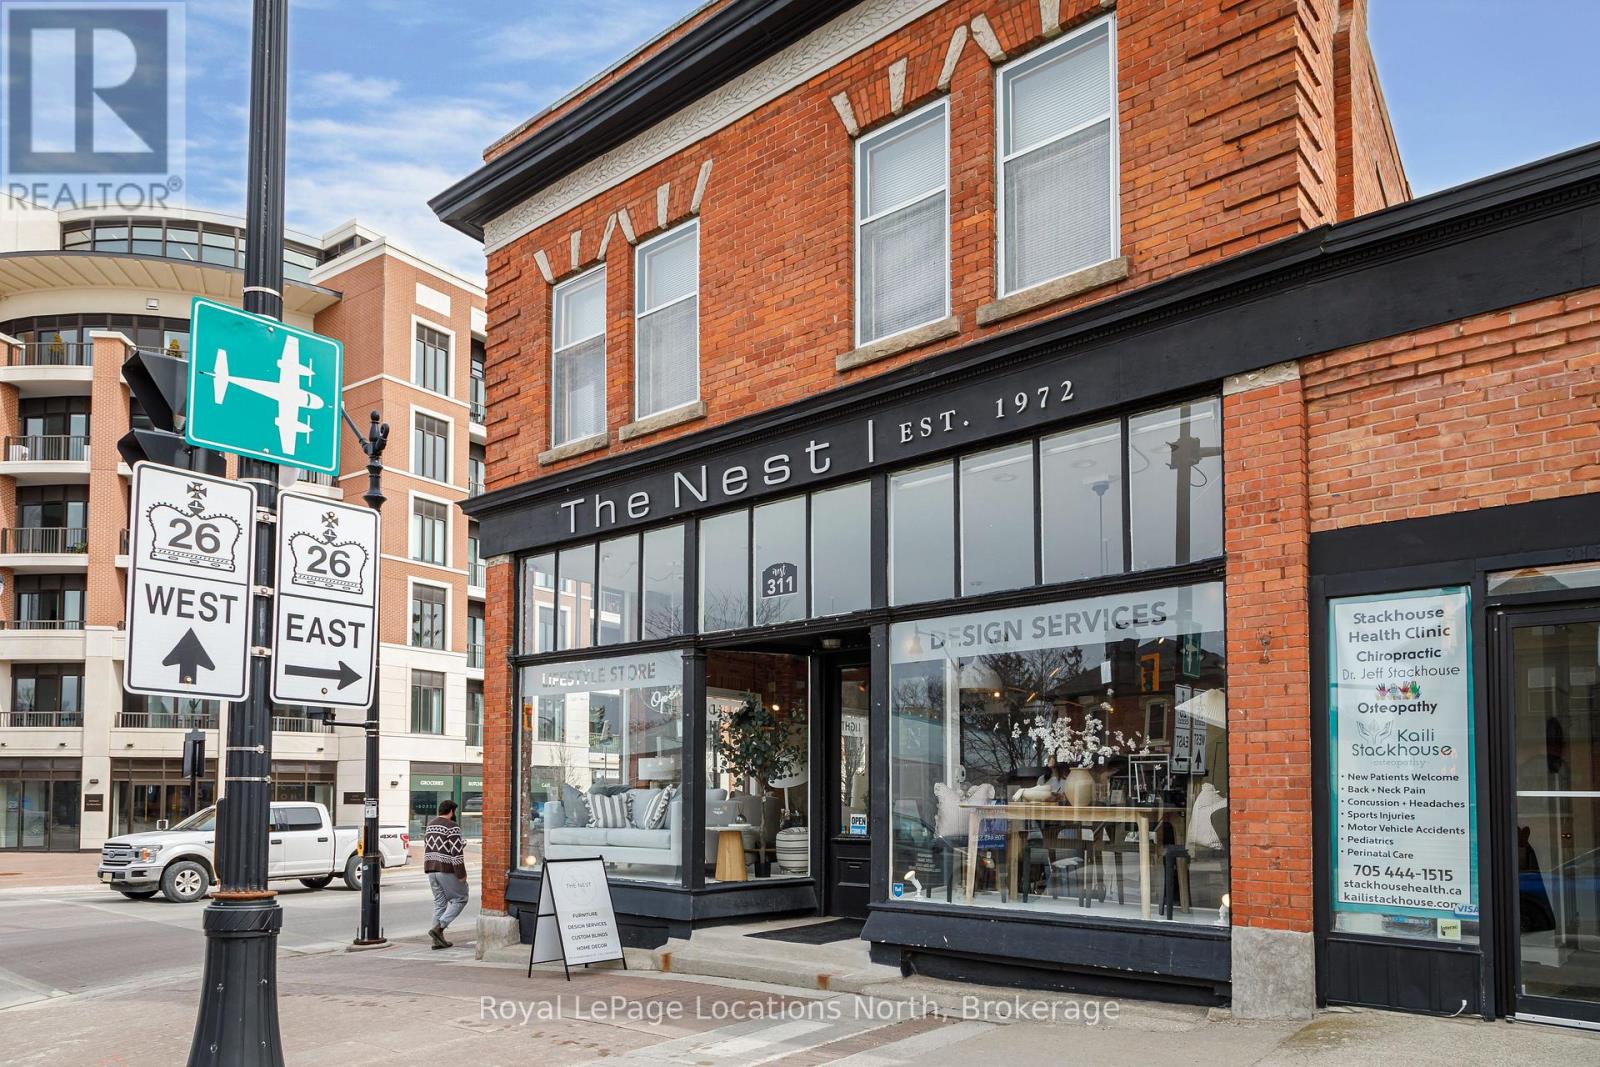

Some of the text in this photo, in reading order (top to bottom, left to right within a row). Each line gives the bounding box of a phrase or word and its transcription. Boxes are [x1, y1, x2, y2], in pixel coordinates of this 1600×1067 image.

[899, 380, 1074, 443] EST. 1972
[561, 440, 830, 533] The Nest
[168, 518, 221, 554] 26
[306, 545, 351, 577] 26
[767, 575, 793, 595] 311
[145, 583, 238, 624] WEST
[1353, 609, 1445, 624] Stackhouse
[286, 613, 365, 649] EAST
[930, 601, 1167, 650] DESIGN SERVICES
[1349, 625, 1451, 643] Health Clinic
[1356, 647, 1442, 662] Chiropractic
[542, 662, 656, 687] LIFESTYLE STORE
[1342, 665, 1460, 680] Dr. Jeff Stackhouse
[651, 686, 683, 713] Open
[1357, 701, 1438, 715] Osteopathy
[1397, 728, 1435, 742] Kaili
[1352, 743, 1453, 757] Stackhouse
[1347, 773, 1460, 782] New Patients Welcome
[1347, 785, 1369, 794] Back
[1377, 786, 1401, 794] Neck
[1403, 787, 1426, 795] Pain
[1347, 798, 1400, 807] Concussion
[1409, 799, 1466, 808] Headaches
[851, 816, 866, 825] OPEN
[1347, 810, 1415, 821] Sports Injuries
[1347, 823, 1466, 835] Motor Vehicle Accidents
[1347, 835, 1395, 845] Pediatrics
[1347, 848, 1414, 859] Perinatal Care
[1353, 864, 1453, 882] 705 444-1515
[1343, 879, 1462, 896] stackhousehealth.ca
[572, 911, 598, 919] FURNITURE
[1457, 905, 1479, 913] VISA
[586, 921, 608, 929] SERVICES
